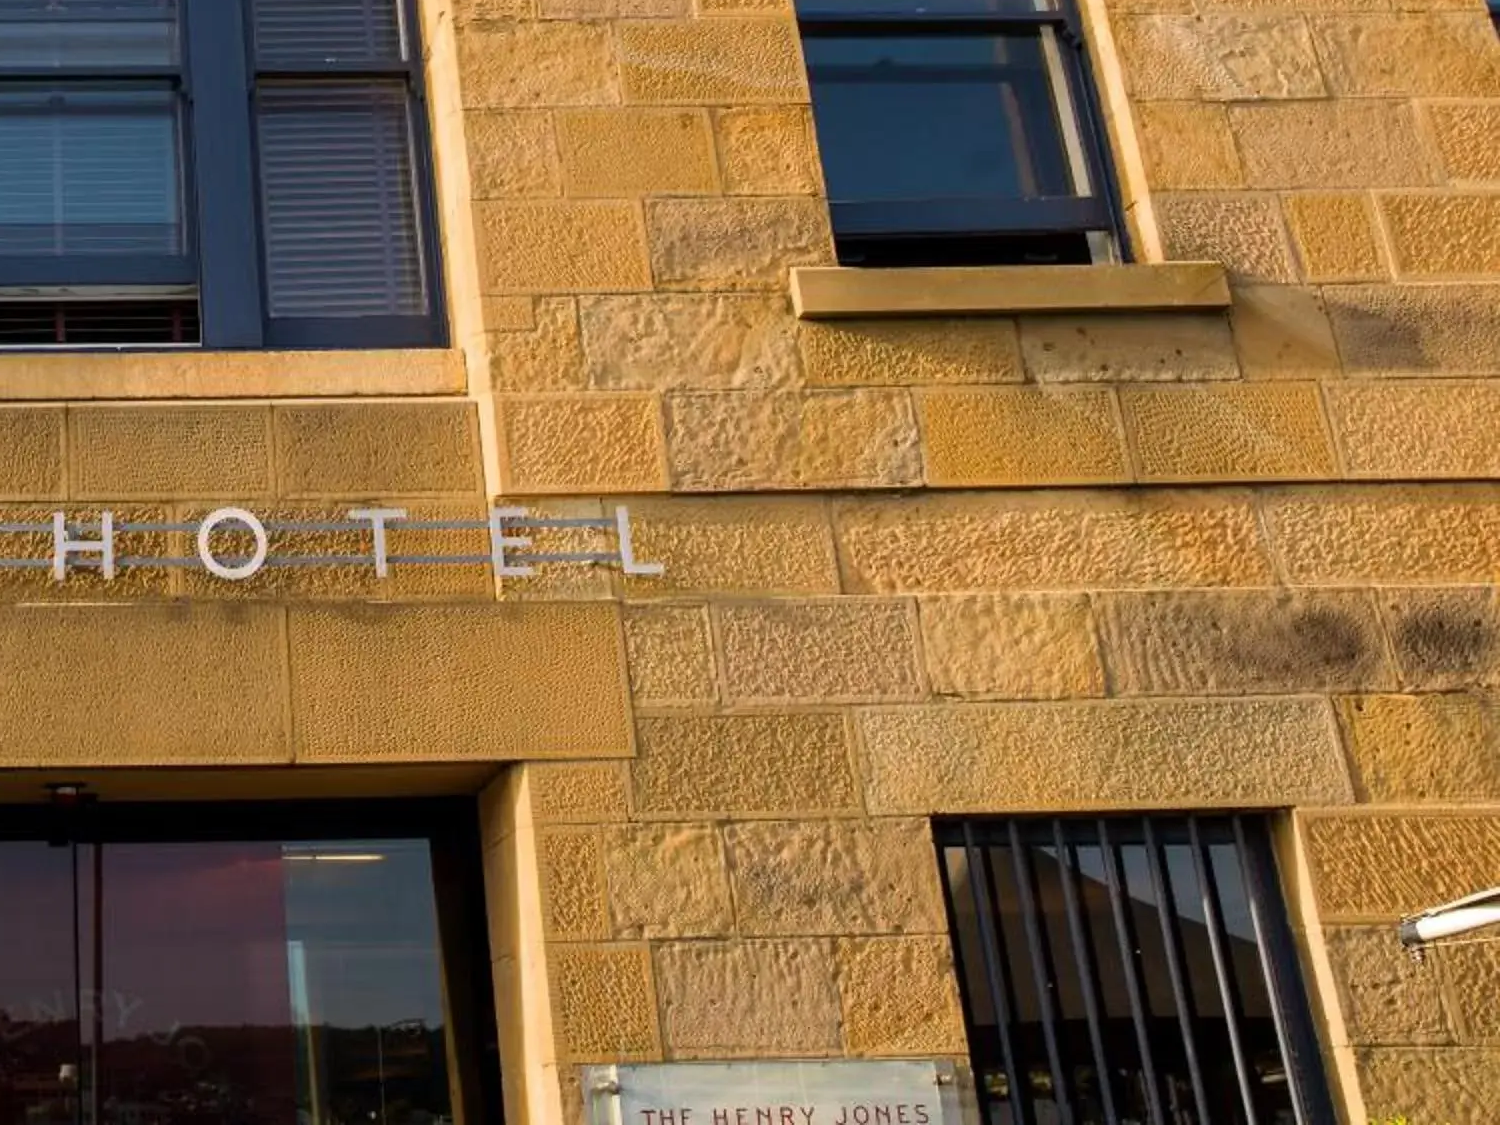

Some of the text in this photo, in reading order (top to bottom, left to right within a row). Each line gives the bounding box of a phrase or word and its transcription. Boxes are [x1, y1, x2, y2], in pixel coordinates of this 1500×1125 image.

[50, 507, 666, 581] HOTEL
[640, 1104, 930, 1125] THE HENRY JONES
